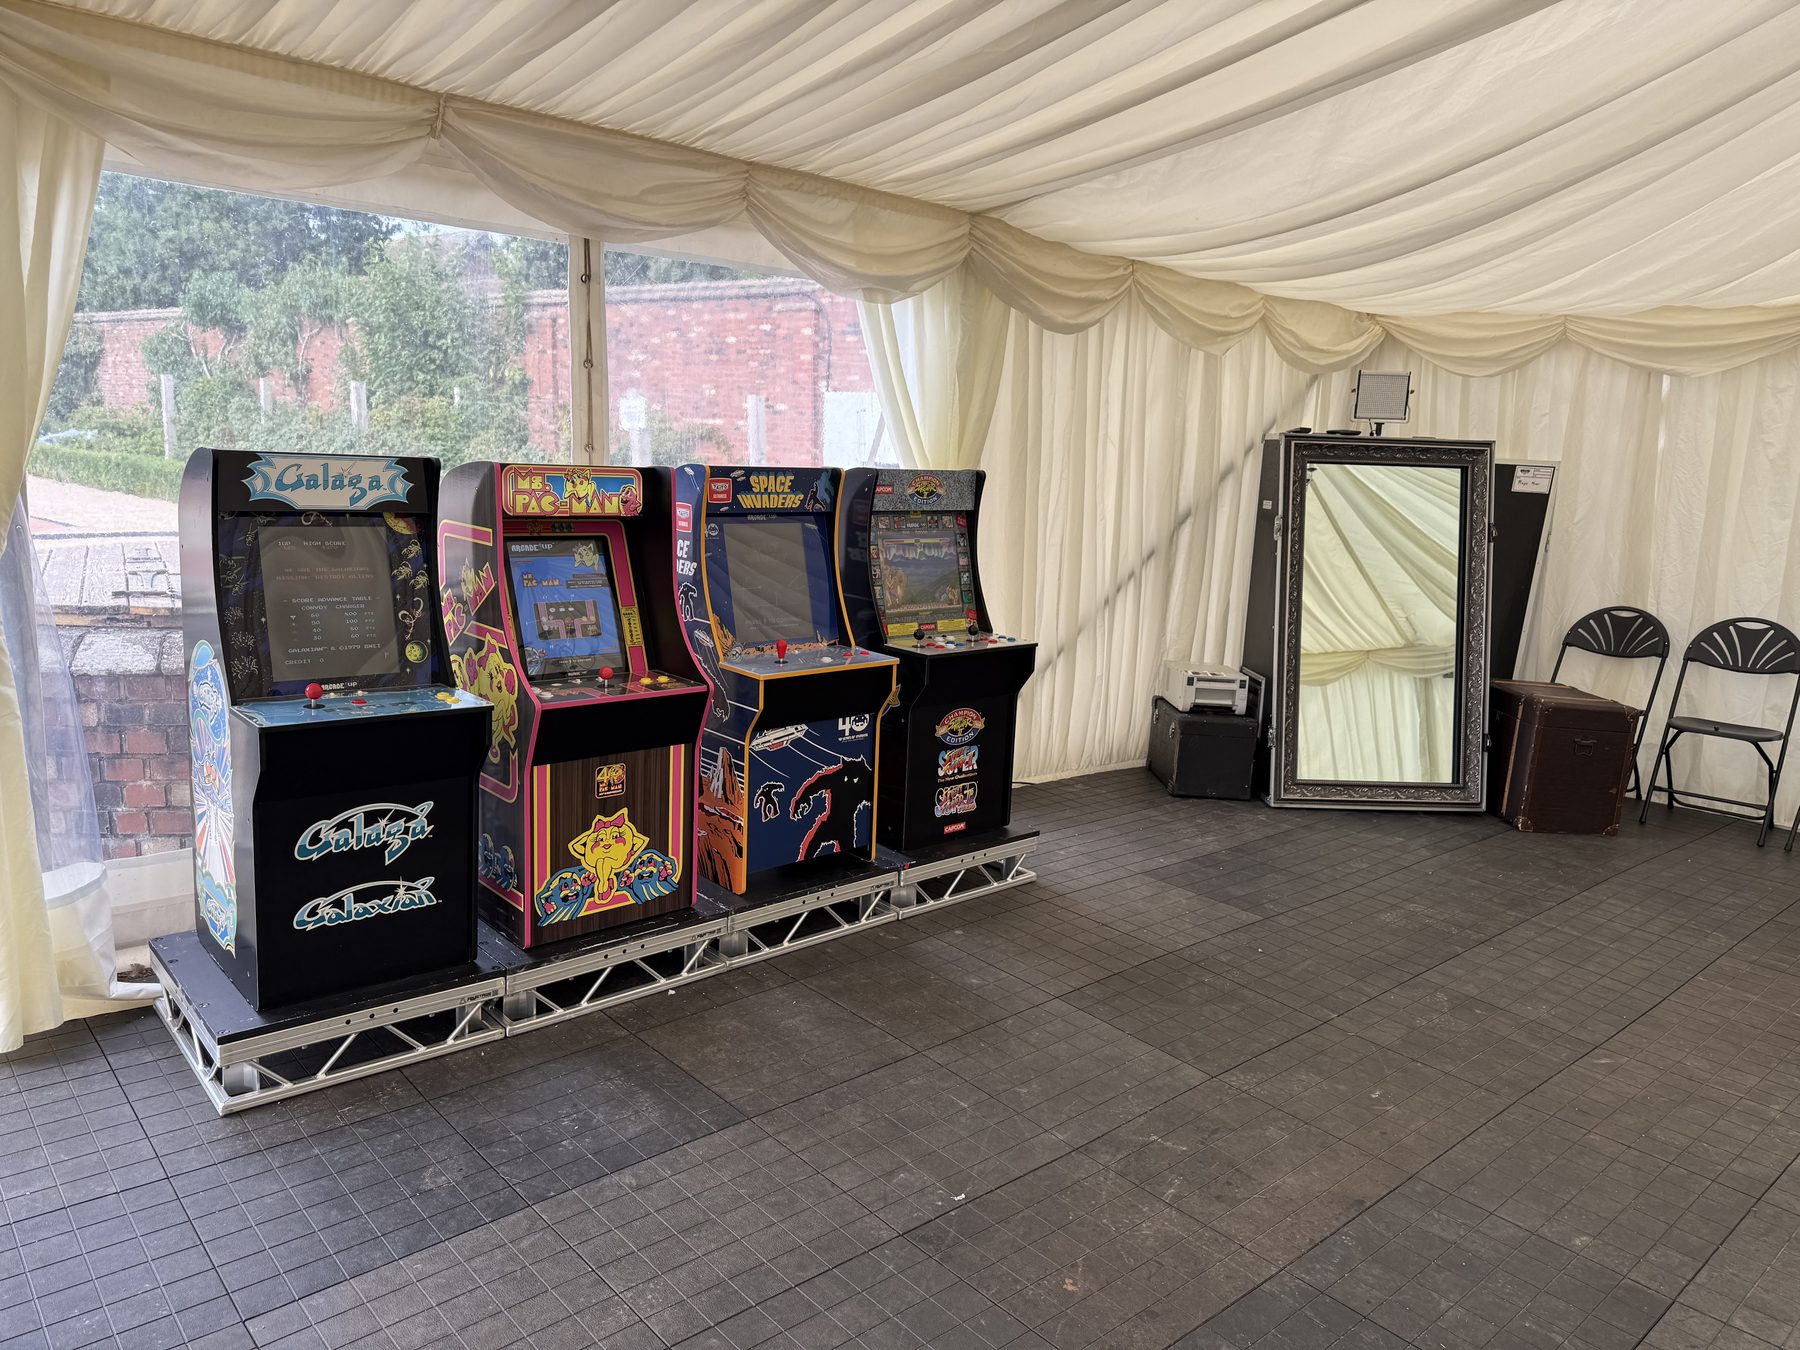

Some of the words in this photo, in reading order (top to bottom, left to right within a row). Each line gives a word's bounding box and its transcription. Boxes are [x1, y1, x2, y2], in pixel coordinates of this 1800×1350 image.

[275, 463, 383, 507] Galaga
[514, 467, 551, 491] MS.
[749, 474, 795, 493] SPACE
[514, 490, 620, 515] PAC-MAN
[736, 494, 805, 509] INVADERS
[945, 710, 976, 724] CHAMPION
[946, 731, 974, 743] EDITION
[294, 801, 435, 866] Galaga
[944, 822, 965, 833] CAPCOM
[293, 877, 437, 931] Galaxian
